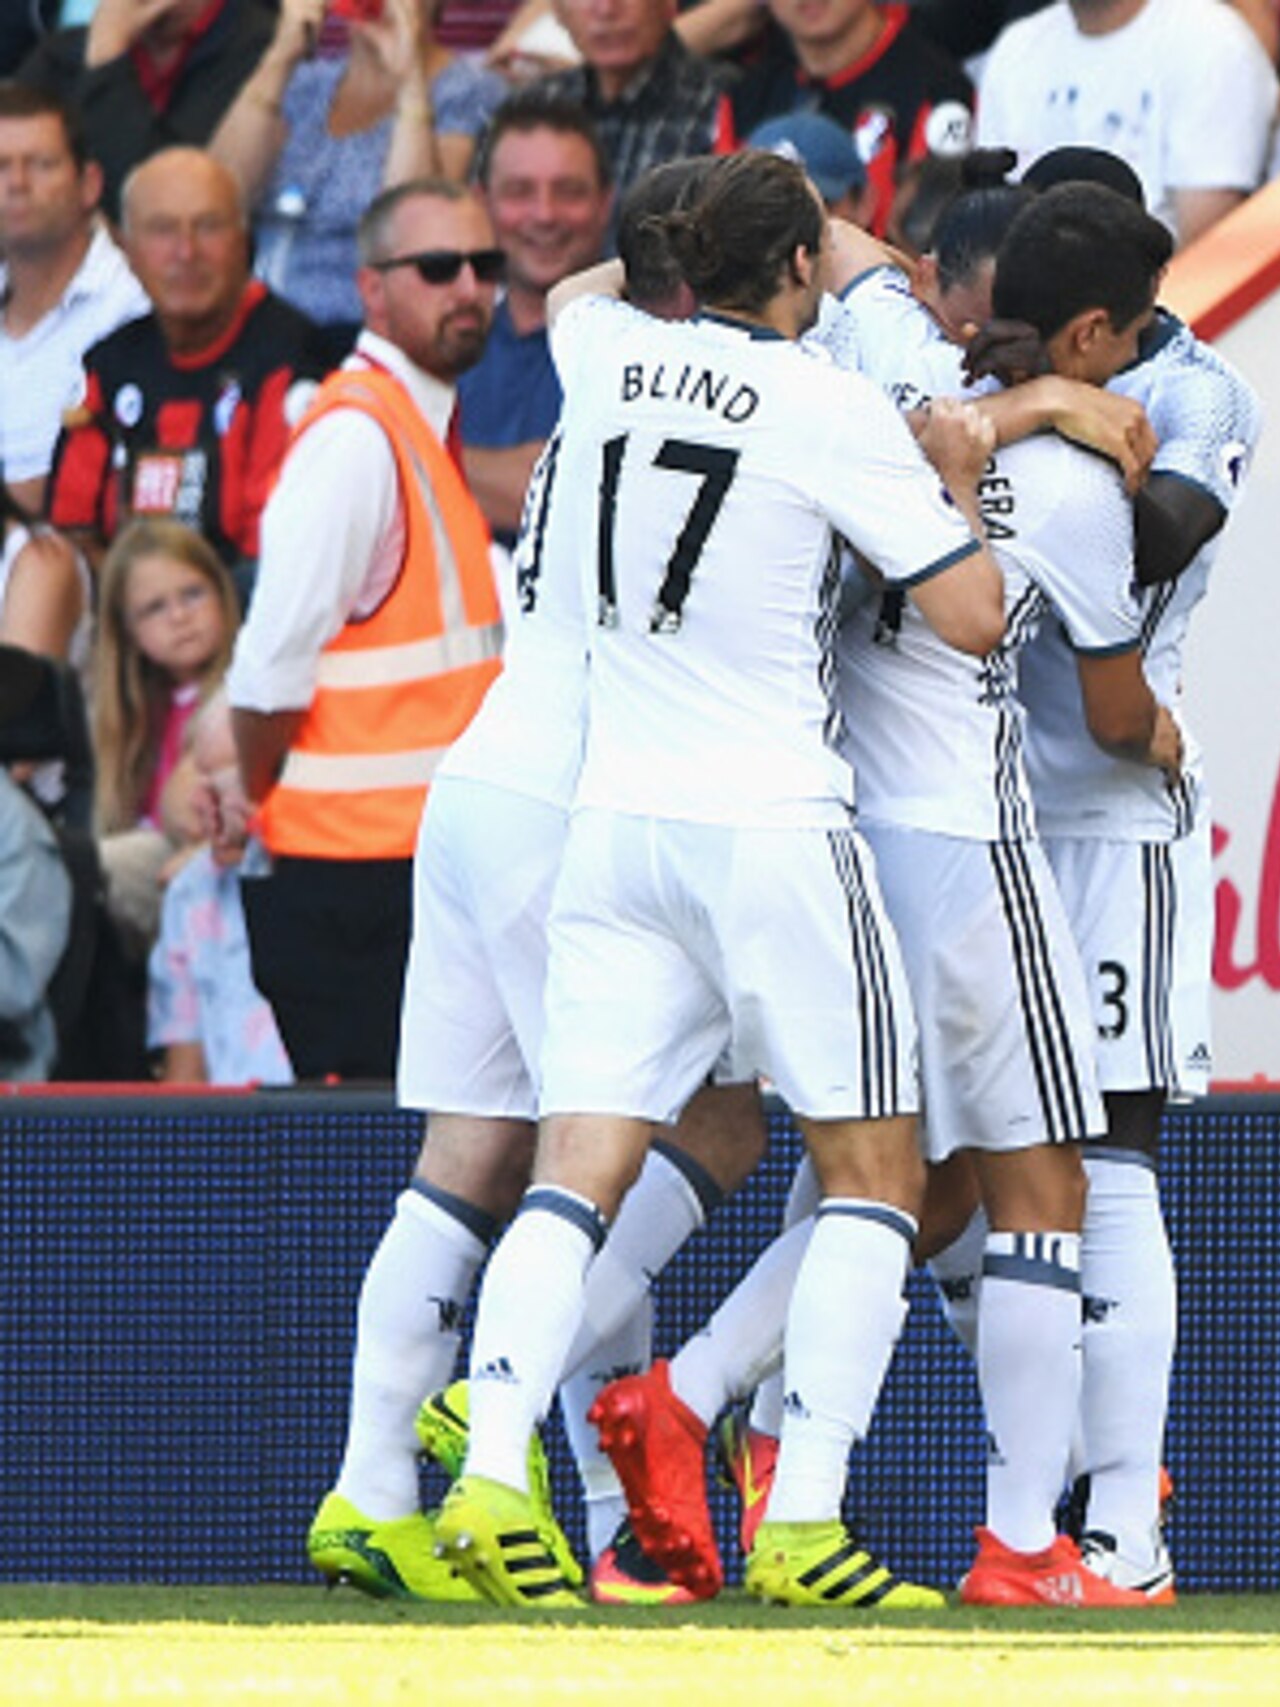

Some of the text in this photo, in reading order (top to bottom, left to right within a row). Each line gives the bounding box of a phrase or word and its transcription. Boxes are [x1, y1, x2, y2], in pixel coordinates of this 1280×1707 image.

[621, 364, 759, 424] BLIND
[598, 432, 740, 633] 17
[1098, 960, 1128, 1039] 3
